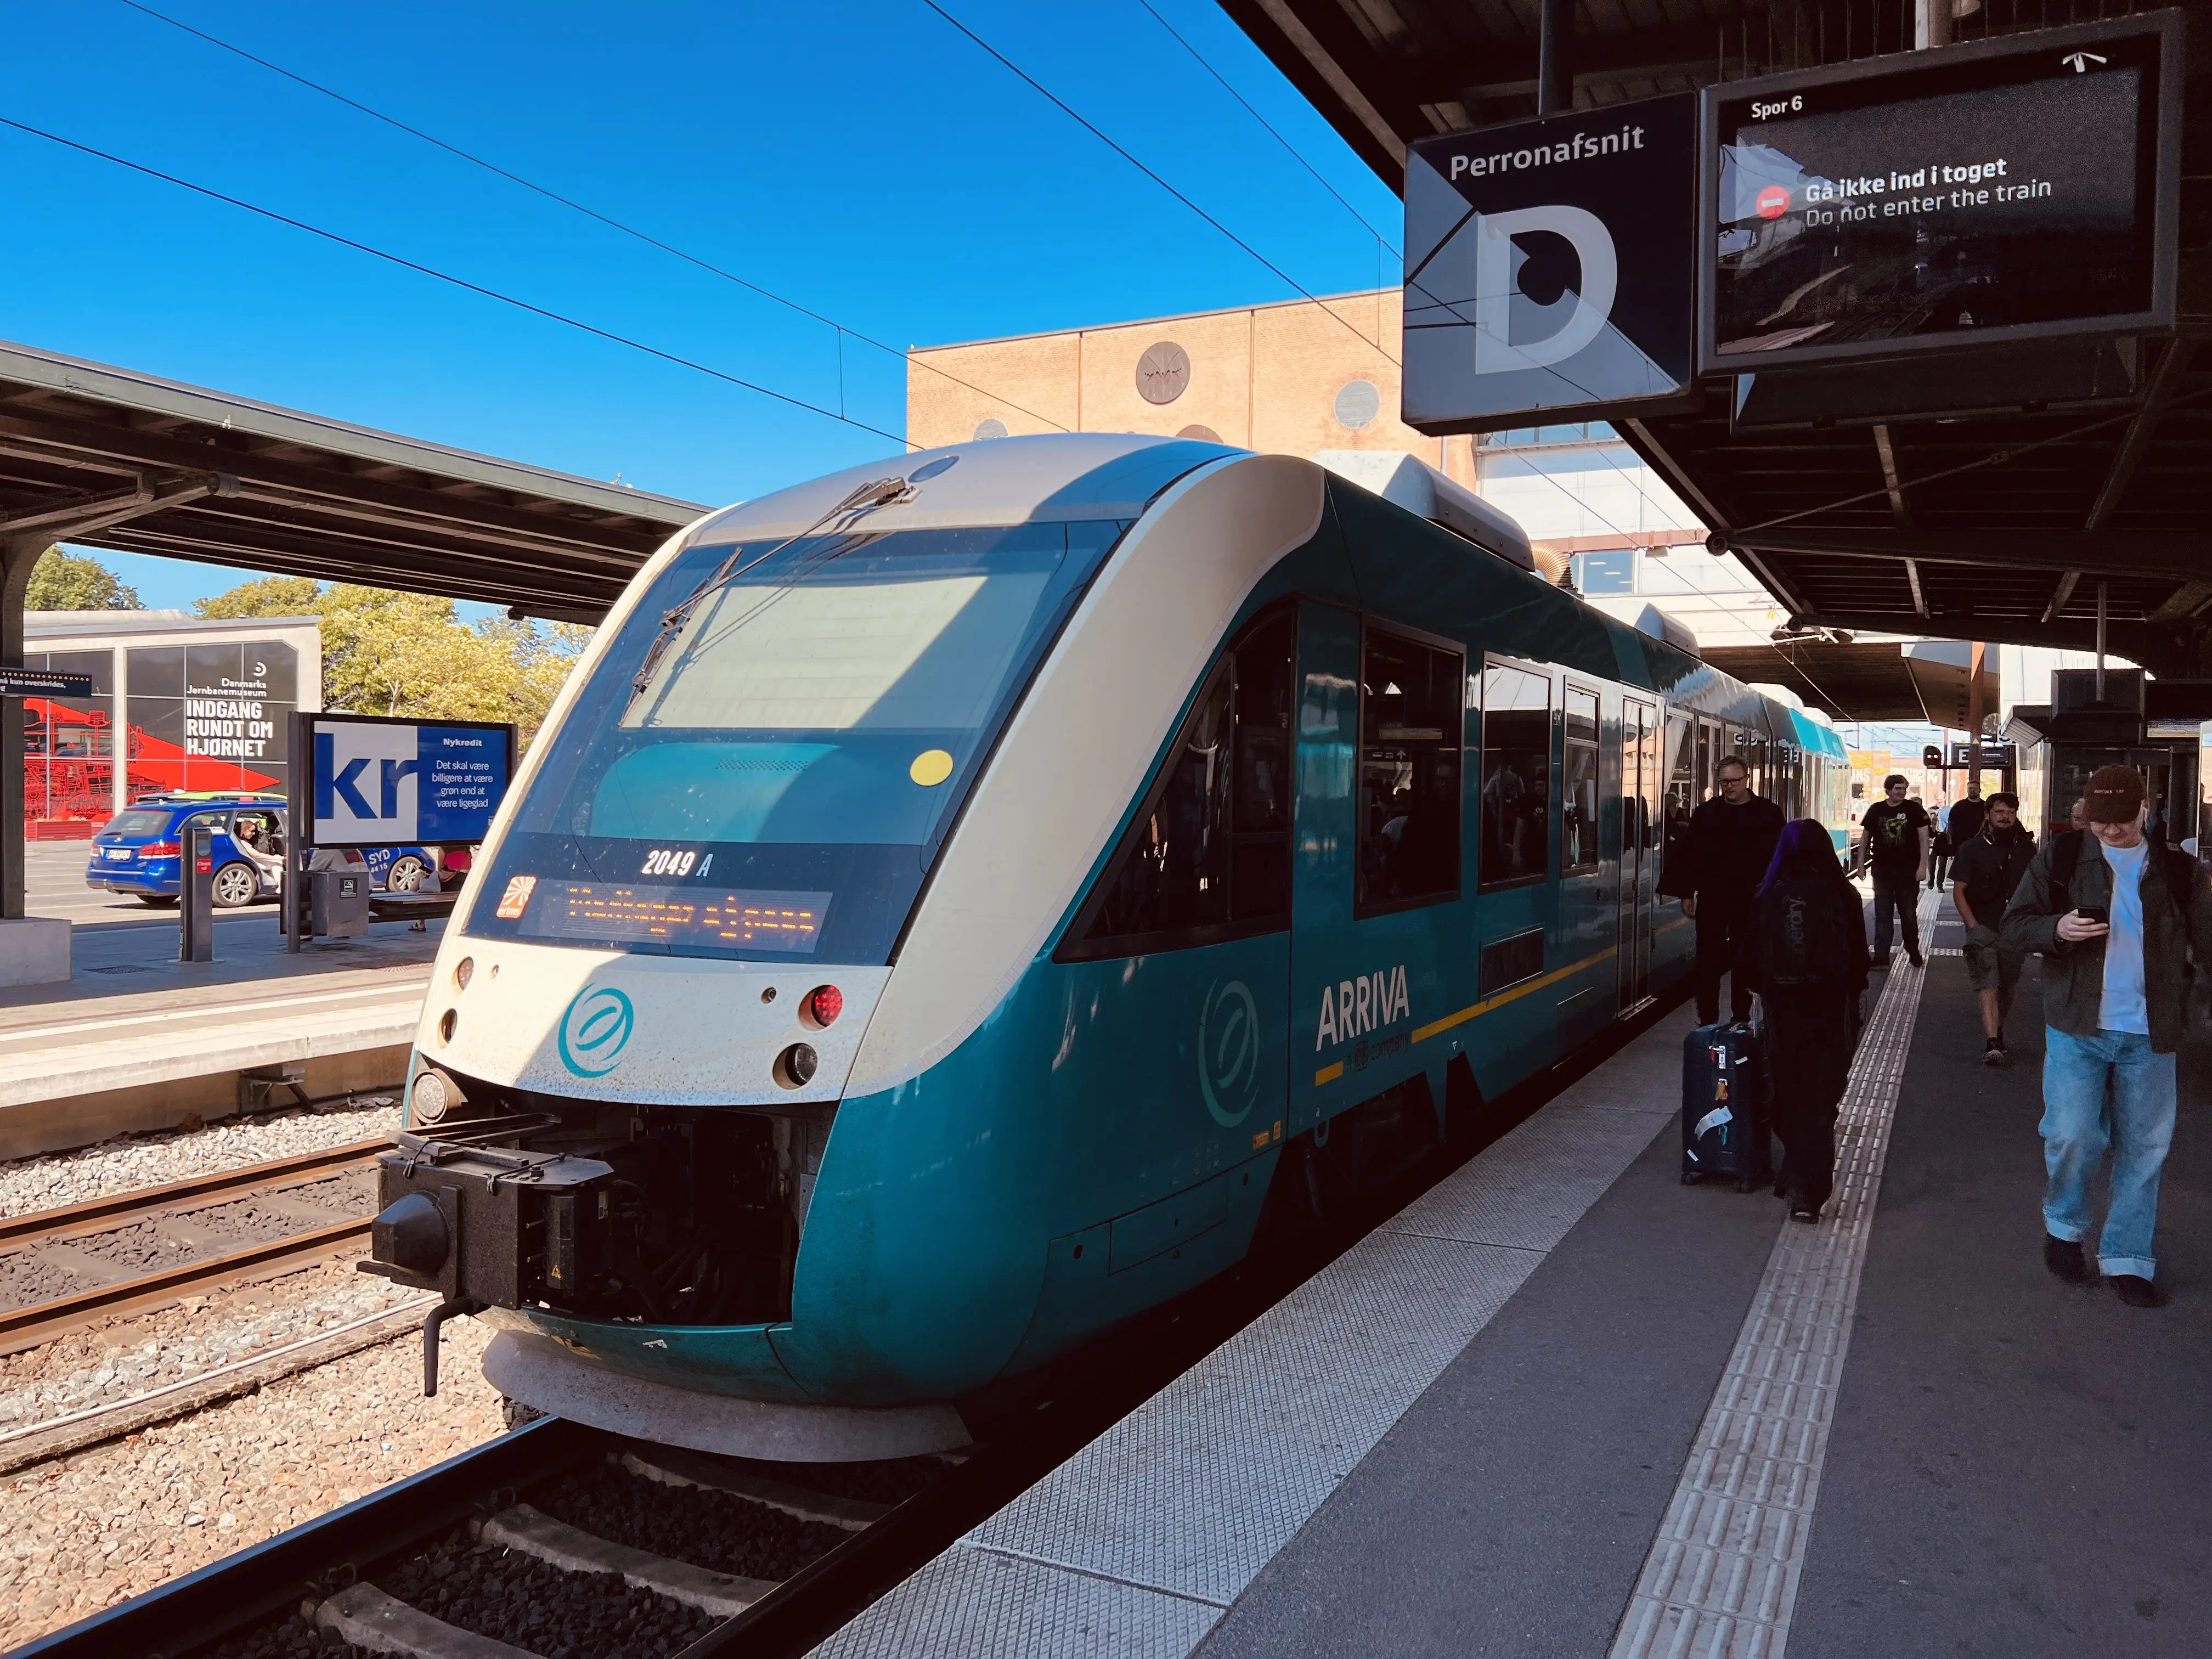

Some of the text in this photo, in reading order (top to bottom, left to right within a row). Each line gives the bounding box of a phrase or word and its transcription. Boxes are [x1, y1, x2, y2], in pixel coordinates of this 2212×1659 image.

[1751, 95, 1803, 120] Spor 6
[1451, 125, 1645, 180] Perronafsnit
[1806, 159, 2007, 202] Gå ikke ind i toget
[1807, 179, 2052, 227] Do not enter the train
[1475, 205, 1618, 375] D
[25, 680, 66, 689] overskrides,
[187, 685, 267, 697] Jernbanemuseum
[222, 678, 267, 689] Danmarks
[187, 699, 262, 719] INDGANG
[187, 719, 273, 738] RUNDT OM
[187, 738, 266, 757] HJØRNET
[443, 738, 482, 747] Nykredit
[1959, 749, 1970, 763] E
[436, 760, 451, 770] Det
[452, 761, 467, 770] skal
[432, 772, 462, 785] billigere
[464, 774, 472, 782] at
[440, 786, 485, 797] grøn end at
[459, 798, 488, 810] ligeglad
[368, 849, 391, 865] SYD
[641, 850, 714, 877] 2049 A
[1316, 965, 1409, 1051] ARRIVA
